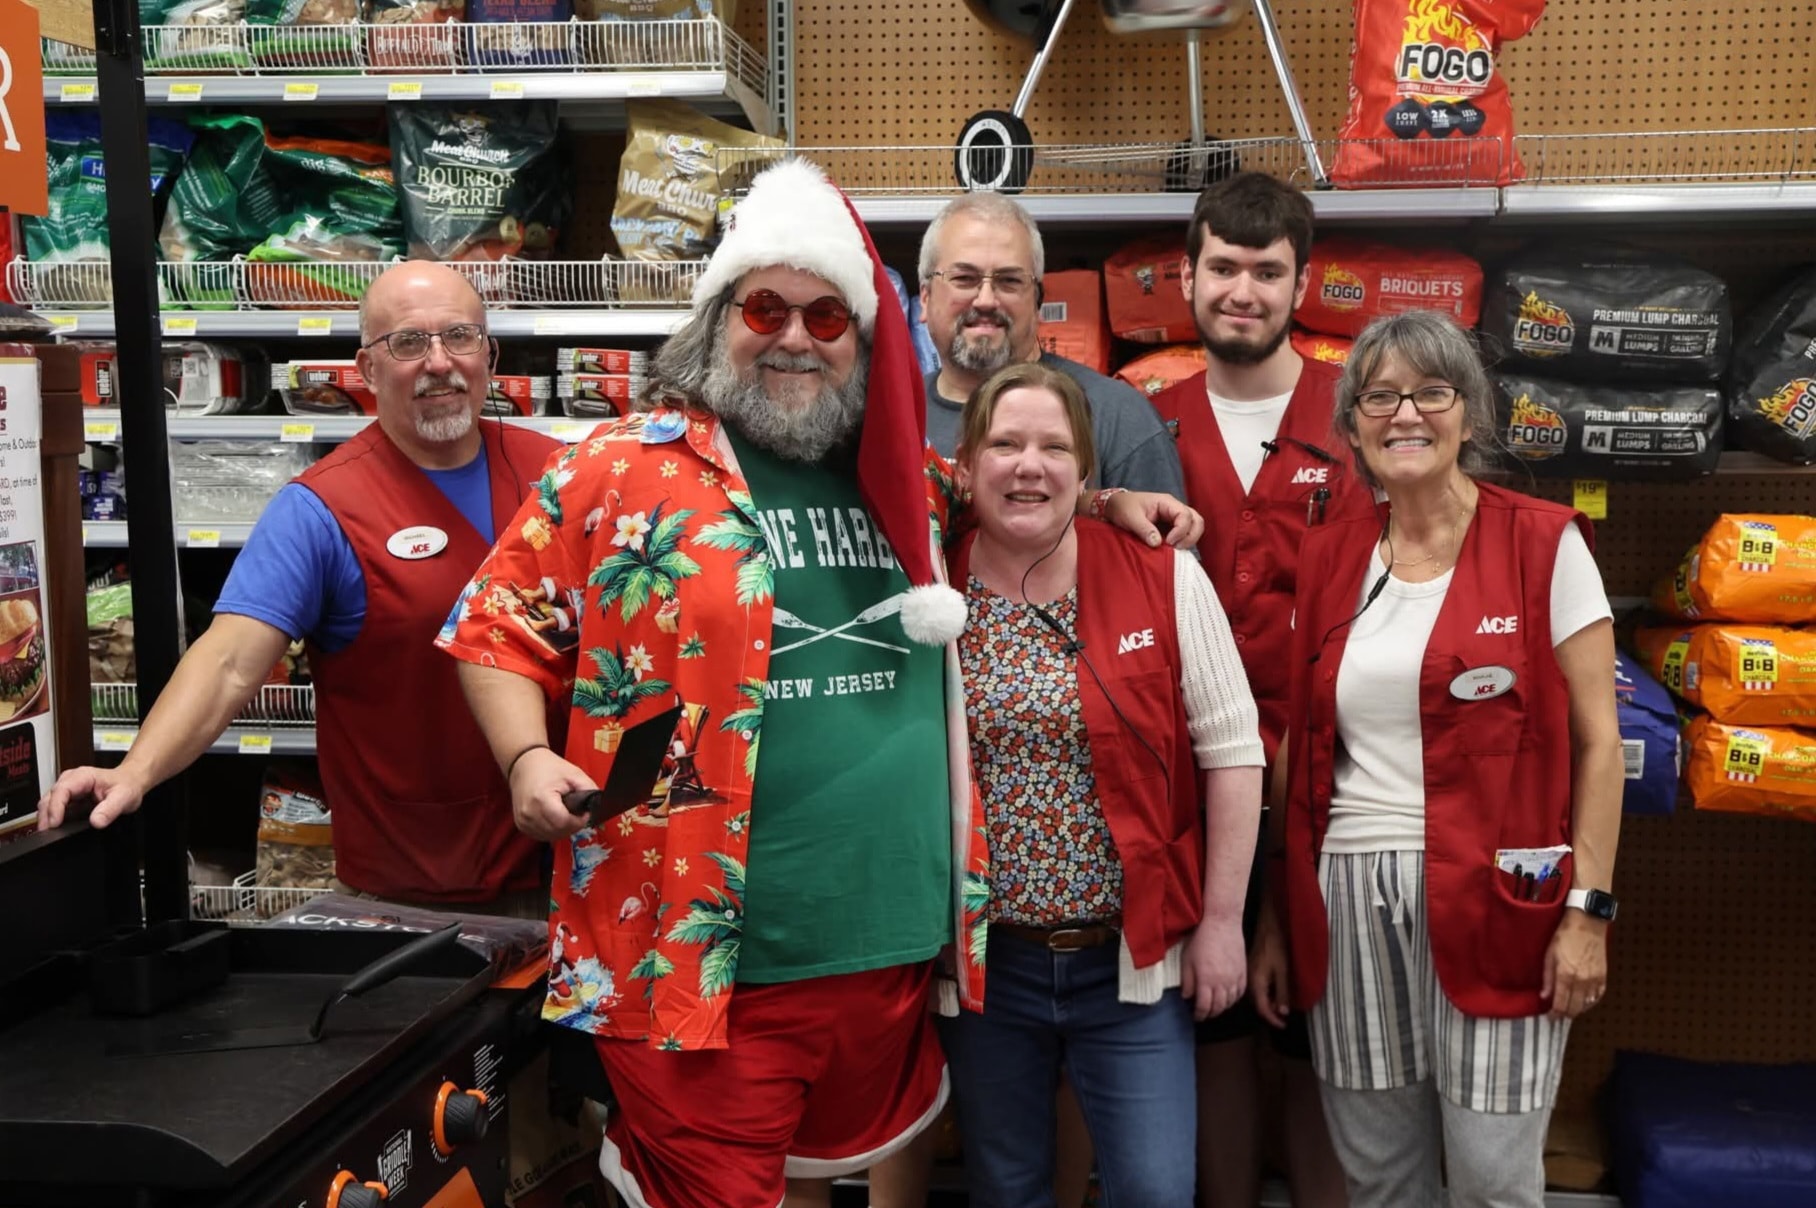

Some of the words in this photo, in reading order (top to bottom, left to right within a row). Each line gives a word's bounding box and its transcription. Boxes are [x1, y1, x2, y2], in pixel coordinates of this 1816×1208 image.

[1400, 44, 1489, 83] FOGO
[1396, 112, 1419, 120] LOW
[428, 186, 505, 207] BARREL
[622, 169, 664, 198] Meat
[663, 179, 718, 212] Chur
[1323, 284, 1363, 300] FOGO
[1380, 277, 1463, 297] BRIQUETS
[1593, 309, 1639, 323] PREMIUM
[1642, 312, 1669, 325] LUMP
[1518, 320, 1571, 343] FOGO
[1593, 329, 1615, 349] M
[1624, 341, 1659, 352] LUMPS
[1585, 410, 1630, 422] PREMIUM
[1631, 411, 1659, 422] LUMP
[1784, 381, 1816, 433] FOGO
[1511, 425, 1564, 445] FOGO
[1586, 431, 1607, 448] M
[1616, 440, 1651, 449] LUMPS
[1290, 466, 1329, 484] ACE
[411, 543, 431, 555] ACE
[806, 507, 903, 573] HARB
[1475, 615, 1518, 634] ACE
[1118, 628, 1155, 655] ACE
[764, 678, 813, 700] NEW
[823, 670, 897, 697] JERSEY
[1474, 683, 1497, 697] ACE
[383, 1141, 408, 1182] GRIDDLE
[387, 1165, 405, 1192] WEEK
